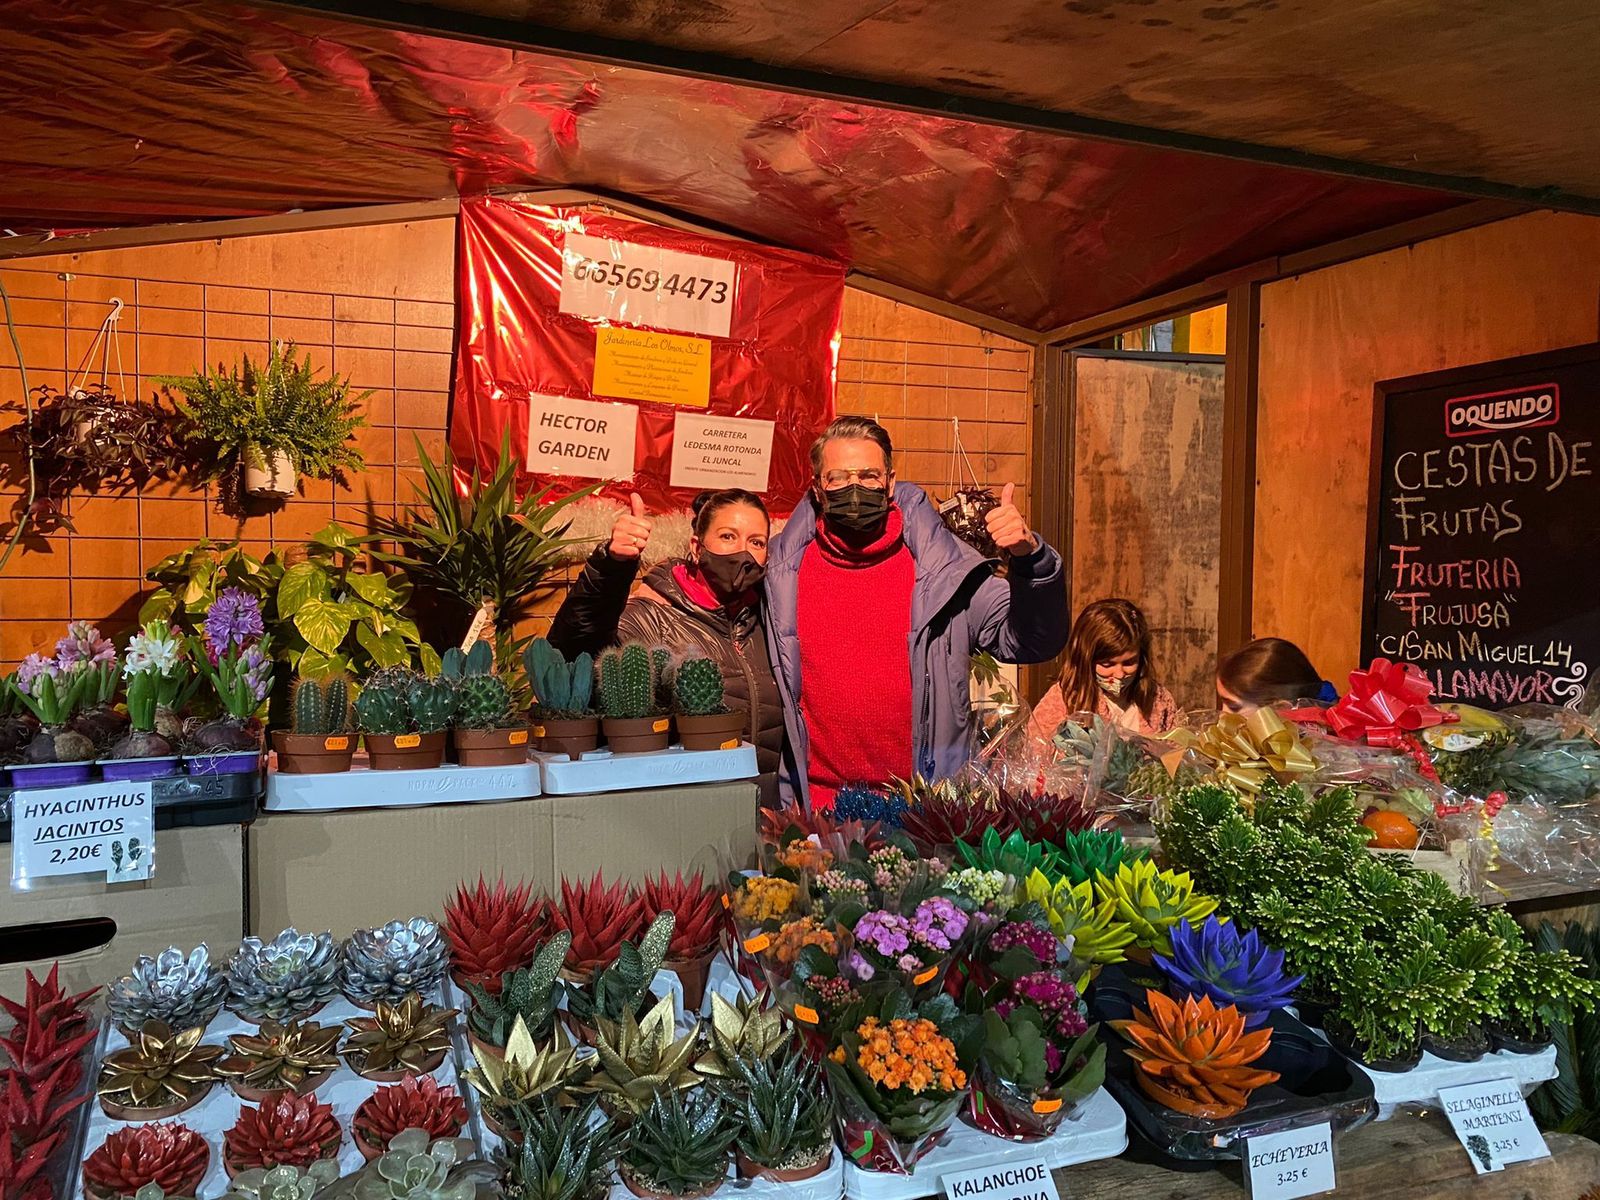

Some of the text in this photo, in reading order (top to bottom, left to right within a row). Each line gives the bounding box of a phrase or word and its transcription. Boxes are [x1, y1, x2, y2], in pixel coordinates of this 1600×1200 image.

[540, 412, 608, 434] HECTOR
[1451, 394, 1553, 429] OQUENDO
[702, 428, 747, 440] CARRETERA
[538, 440, 610, 461] GARDEN
[683, 440, 762, 455] LEDESMA ROTONDA
[702, 455, 742, 467] EL JUNCAL
[1394, 431, 1593, 491] CESTAS DE
[1391, 493, 1523, 543] FRUTAS
[1389, 544, 1521, 590] FRUTERIA
[1457, 630, 1541, 665] MIGUEL
[1425, 667, 1555, 704] LAMAYOR
[24, 792, 145, 819] HYACINTHUS
[33, 817, 124, 842] JACINTOS
[50, 844, 102, 865] 2,20€
[1446, 1091, 1523, 1113] SELAGINELLA
[1463, 1110, 1523, 1130] MARTENSI
[1252, 1140, 1329, 1168] ECHEVERIA
[1493, 1138, 1520, 1152] 3.25 €
[952, 1164, 1047, 1198] KALANCHOE
[1277, 1168, 1308, 1186] 3.25 €
